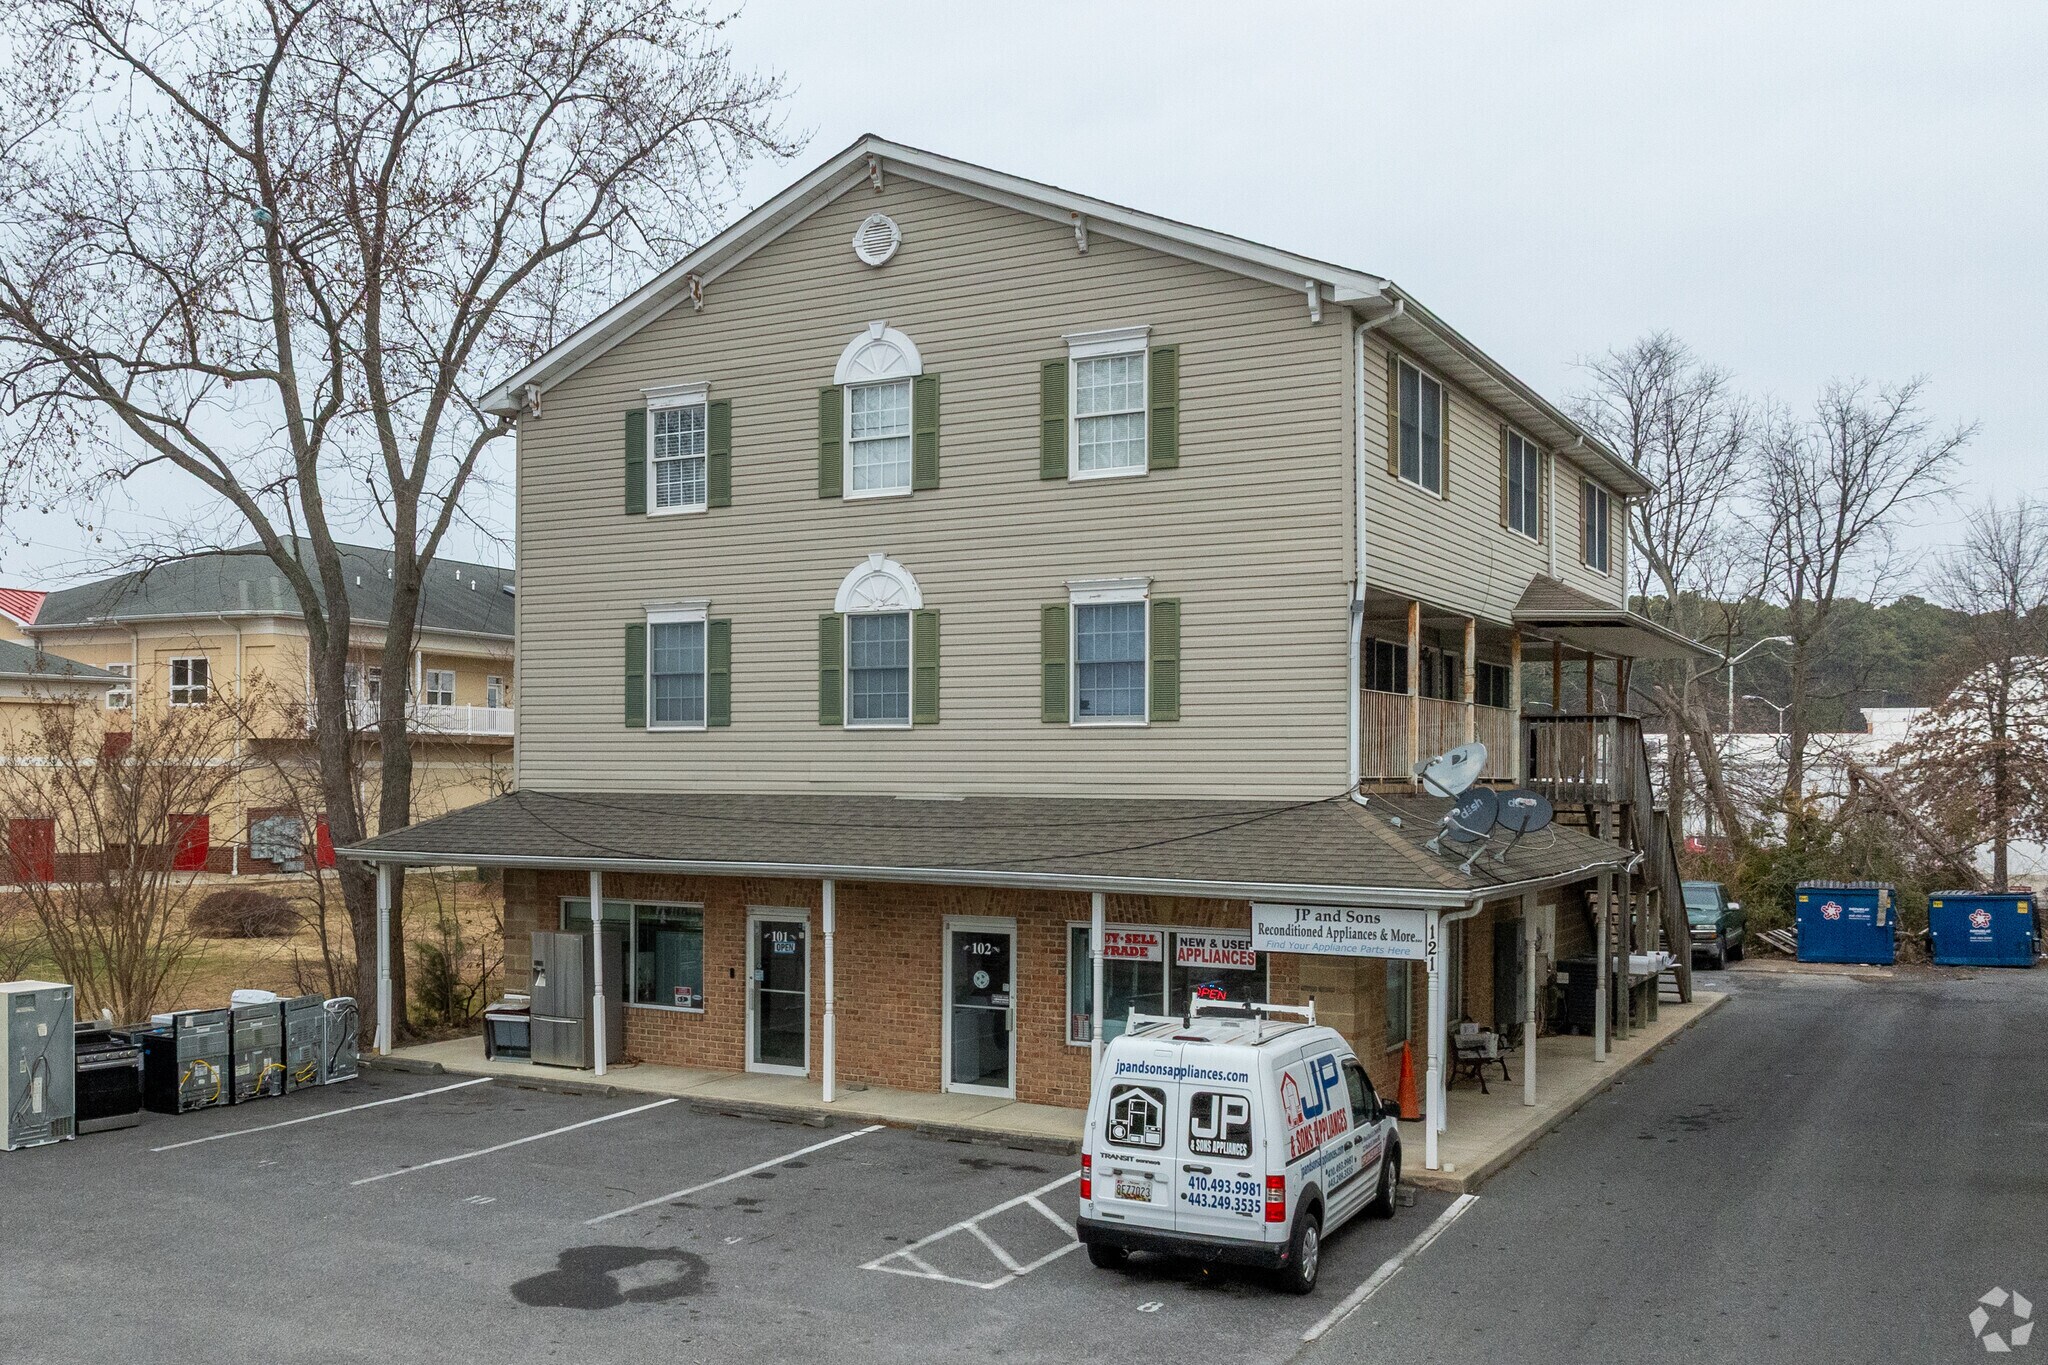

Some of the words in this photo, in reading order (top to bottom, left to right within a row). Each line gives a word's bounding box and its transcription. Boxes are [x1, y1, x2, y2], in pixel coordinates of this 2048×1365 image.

[1460, 798, 1483, 819] dish
[1294, 908, 1311, 924] JP
[1315, 910, 1341, 923] and
[1346, 910, 1381, 924] Sons
[771, 930, 788, 943] 101
[1258, 922, 1323, 938] Reconditioned
[1326, 926, 1377, 942] Appliances
[1380, 928, 1388, 941] &
[1391, 929, 1422, 943] More...
[776, 943, 794, 952] OPEN
[972, 942, 992, 955] 102
[1180, 937, 1206, 948] NEW
[1209, 938, 1218, 949] &
[1266, 940, 1285, 949] Find
[1289, 941, 1309, 950] Your
[1312, 941, 1357, 953] Appliance
[1360, 944, 1385, 954] Parts
[1387, 946, 1411, 956] Here
[1178, 947, 1255, 966] APPLIANCES
[1115, 1058, 1249, 1083] jpandsonsappliances.com
[1300, 1053, 1339, 1120] JP
[1191, 1094, 1250, 1140] JP
[1290, 1135, 1296, 1158] &
[1296, 1123, 1314, 1155] SONS
[1313, 1107, 1348, 1146] APPLIANCES
[1100, 1152, 1134, 1162] TRANSIT
[1190, 1139, 1195, 1151] &
[1196, 1139, 1212, 1152] SONS
[1212, 1140, 1248, 1156] APPLIANCES
[1188, 1175, 1261, 1197] 410.493.9981
[1188, 1192, 1261, 1214] 443.249.3535
